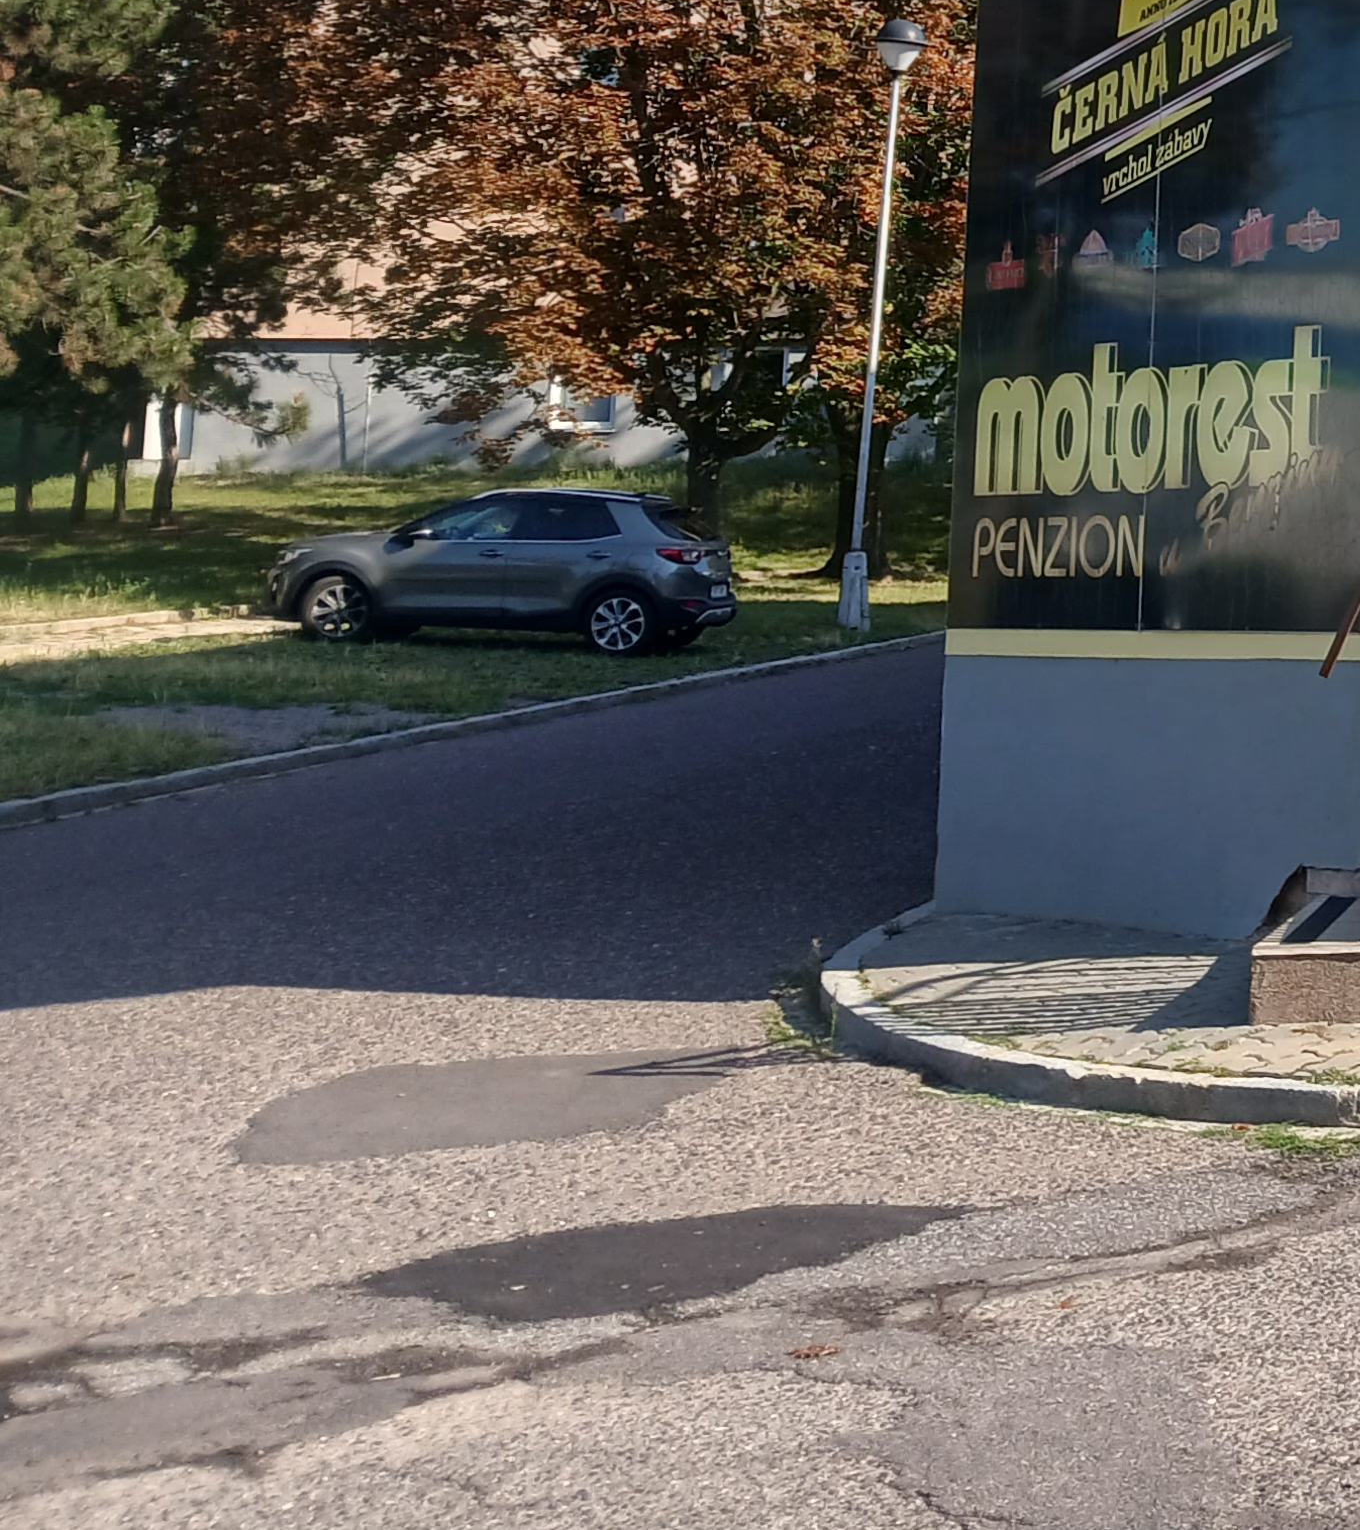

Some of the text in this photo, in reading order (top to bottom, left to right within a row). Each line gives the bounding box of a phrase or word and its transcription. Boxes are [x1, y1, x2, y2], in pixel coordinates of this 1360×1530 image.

[1051, 30, 1169, 155] ČERNÁ
[1102, 117, 1213, 196] vrchol zábavy
[973, 325, 1331, 497] motorest
[972, 515, 1145, 578] PENZION
